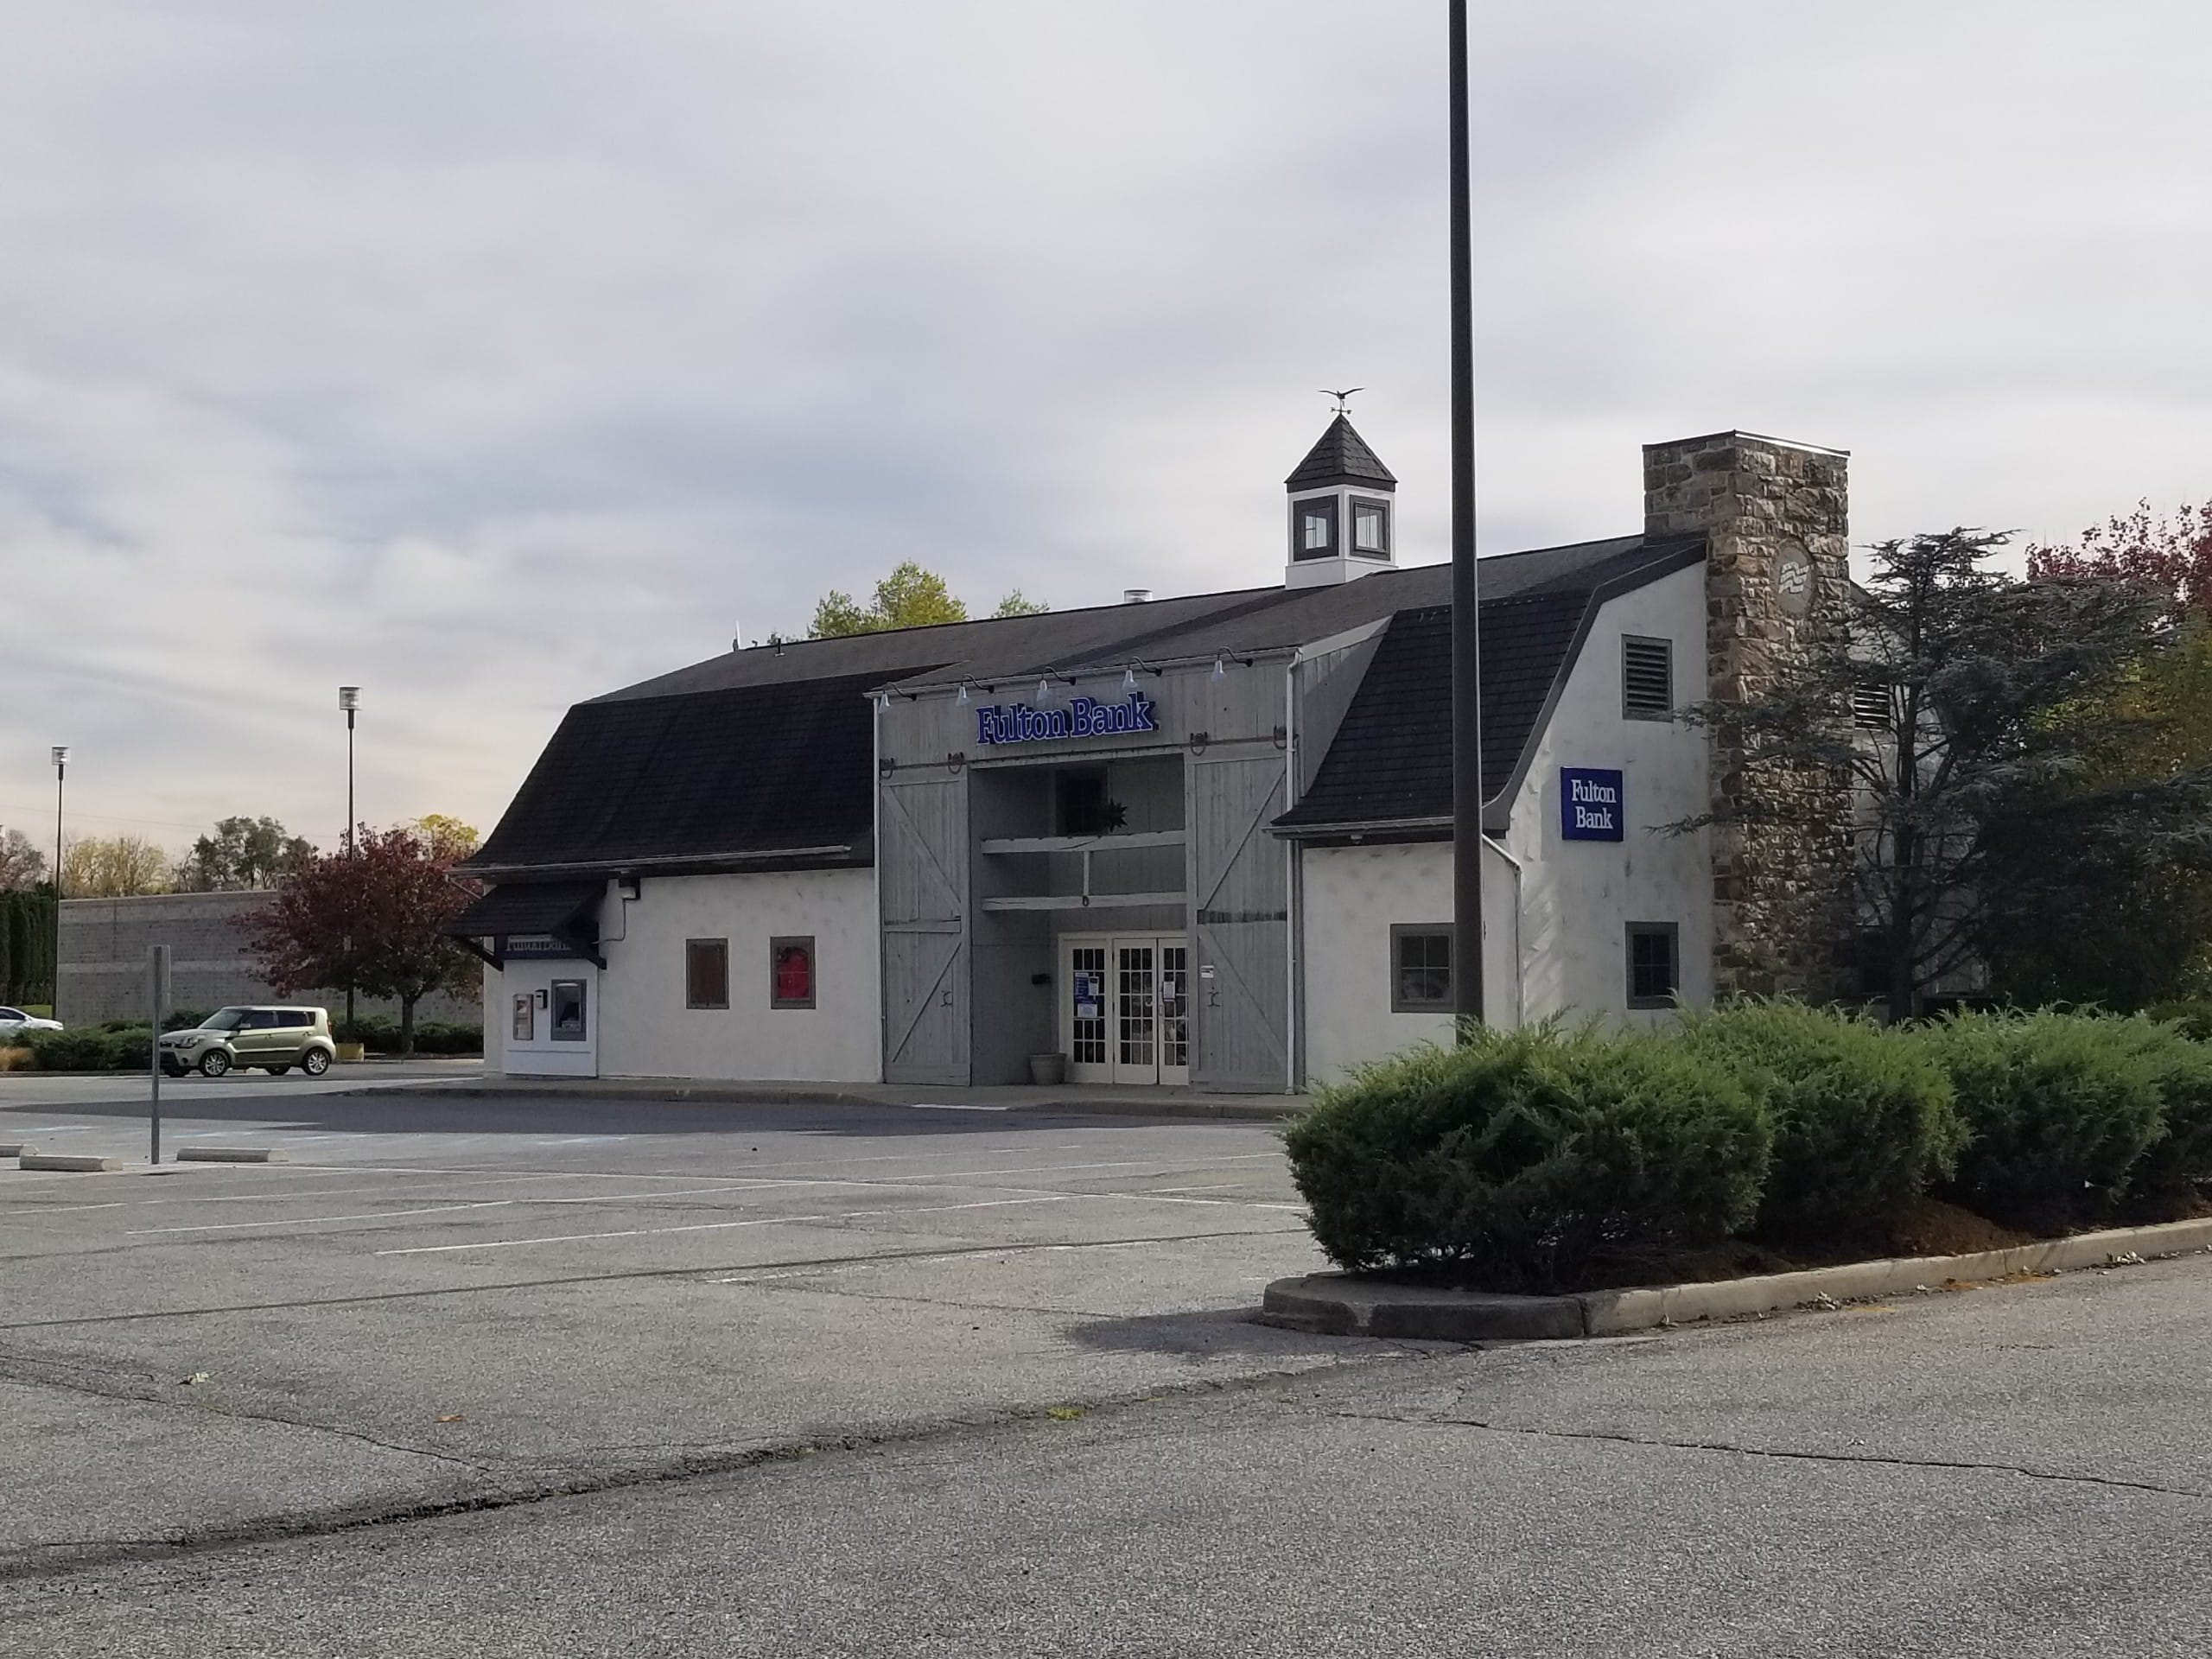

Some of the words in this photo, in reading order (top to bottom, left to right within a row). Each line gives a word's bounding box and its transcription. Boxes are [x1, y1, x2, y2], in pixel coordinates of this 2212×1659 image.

[976, 704, 1068, 746] Fulton
[1069, 691, 1156, 737] Bank
[1571, 779, 1617, 804] Fulton
[1575, 806, 1613, 830] Bank
